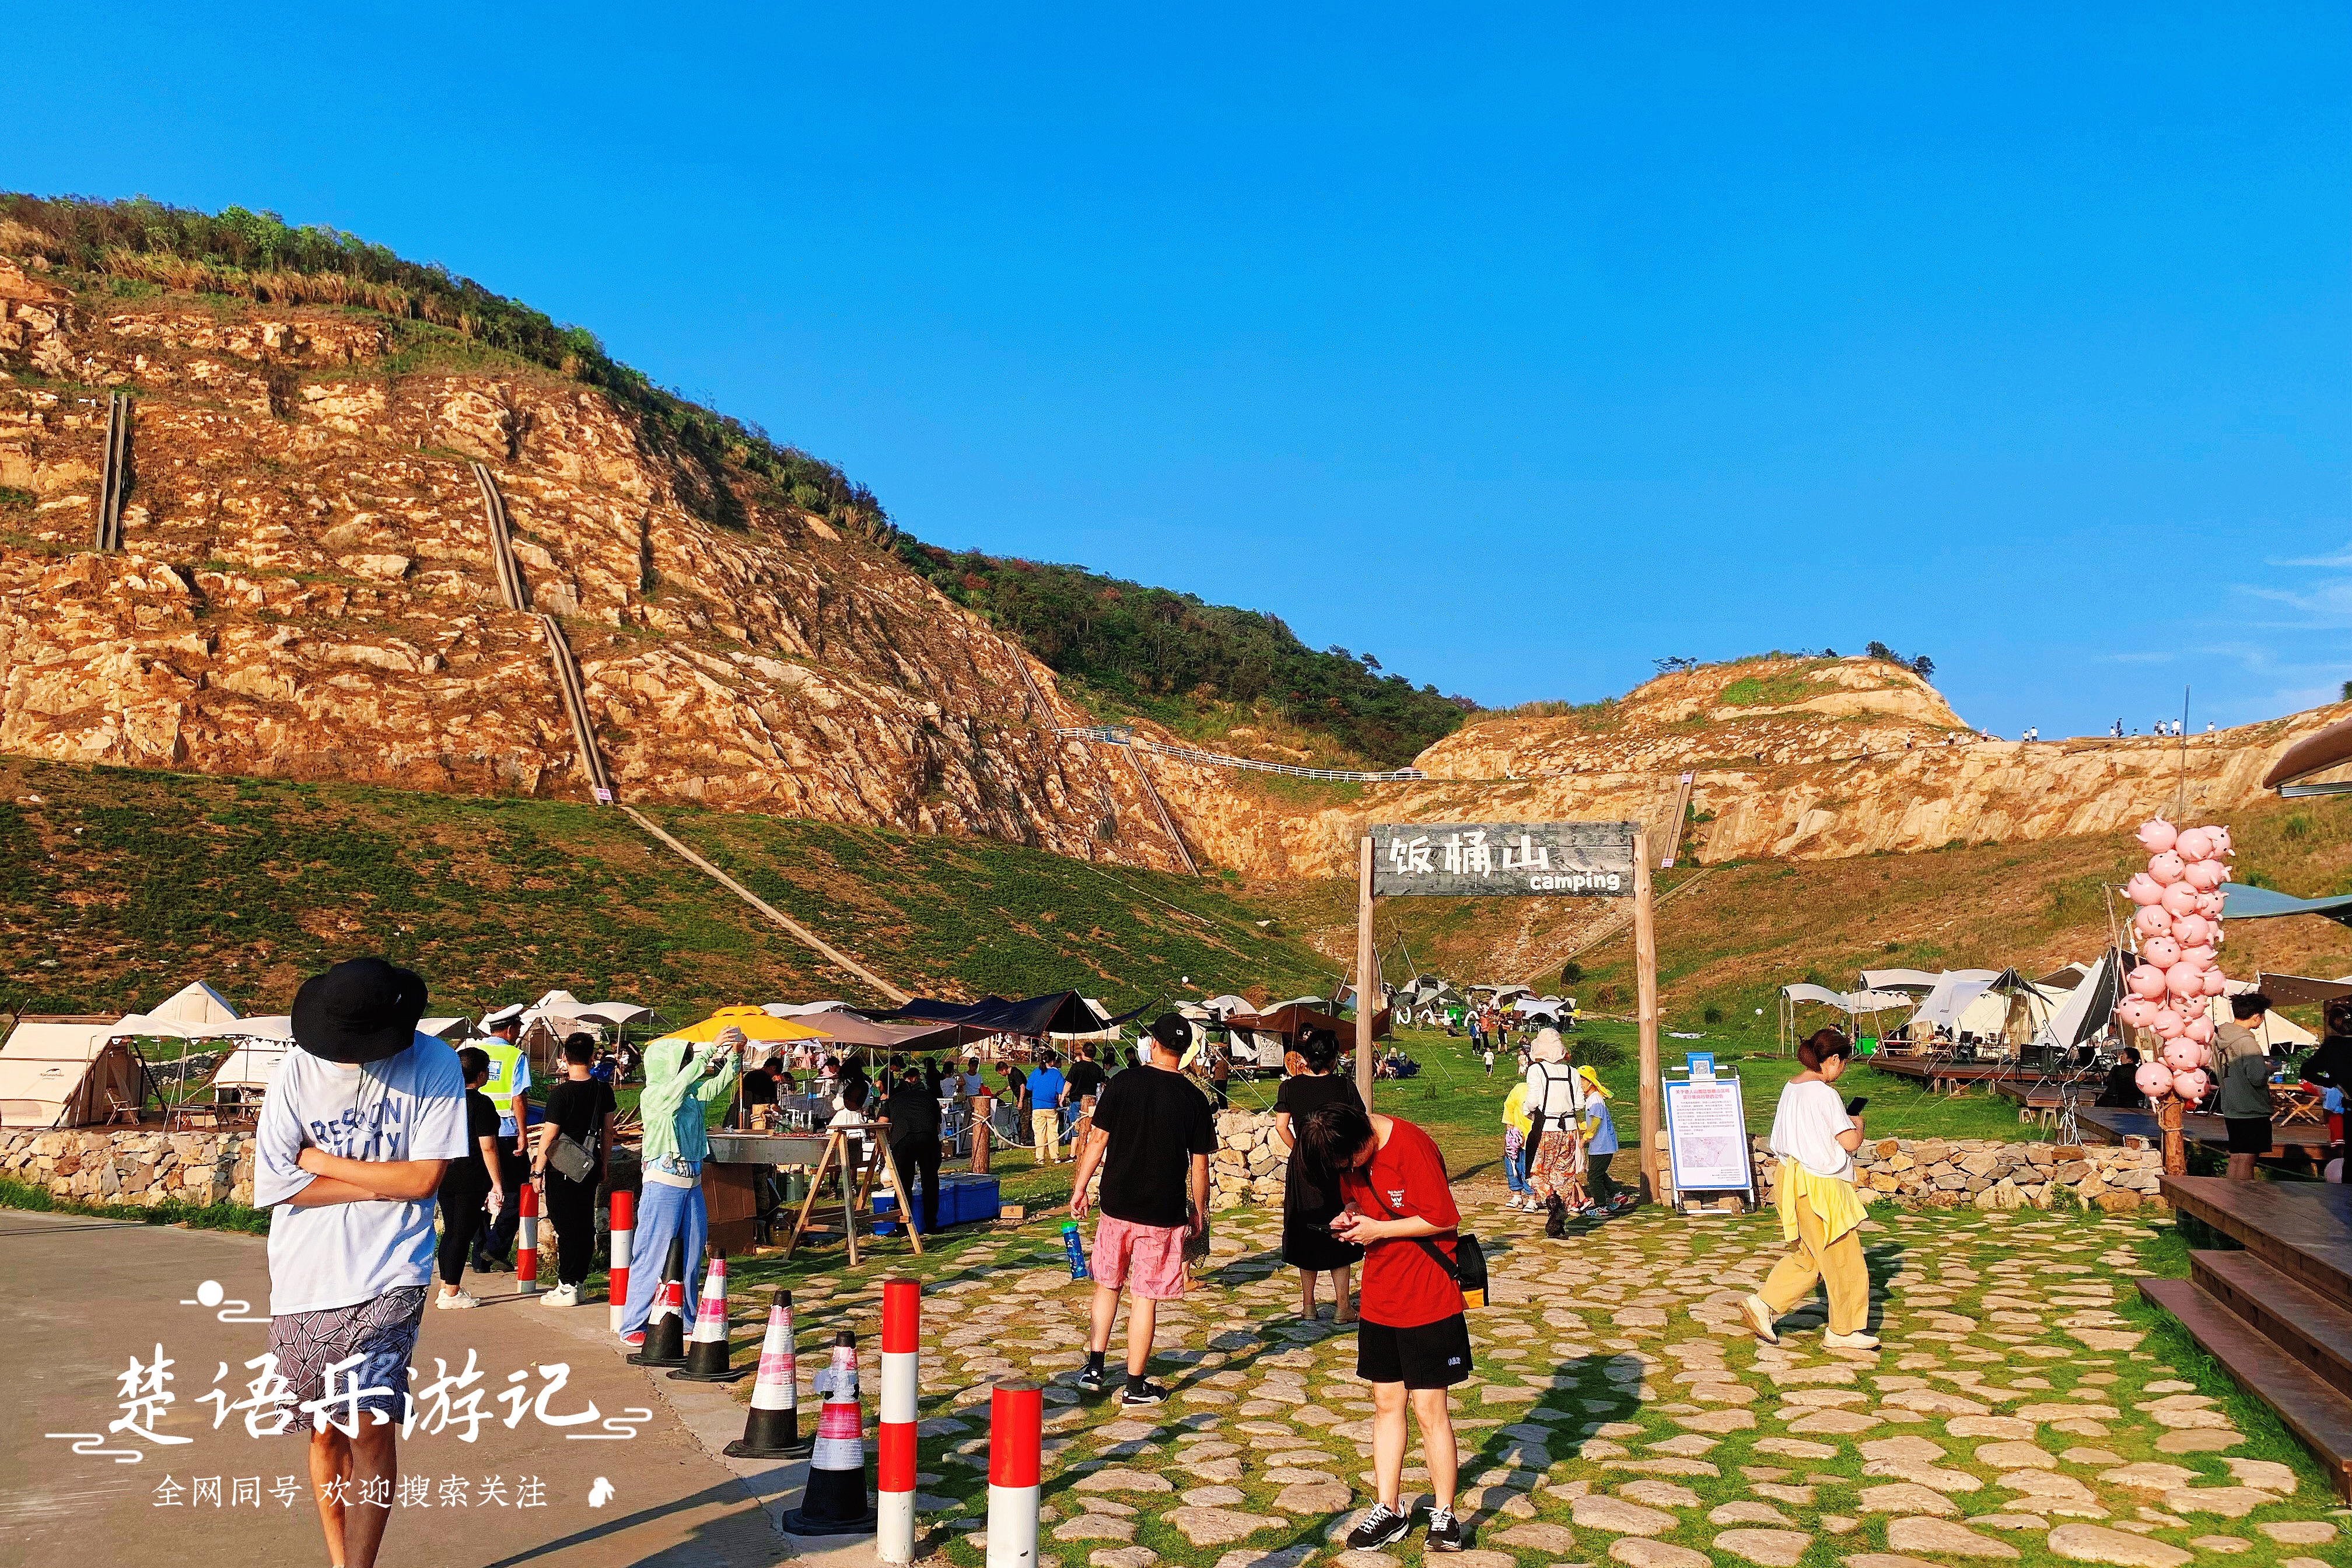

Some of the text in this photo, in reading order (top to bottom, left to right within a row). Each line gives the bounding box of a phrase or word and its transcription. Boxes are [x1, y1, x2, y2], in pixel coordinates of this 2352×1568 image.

[1389, 830, 1549, 878] 饭桶山
[1530, 872, 1620, 891] camping
